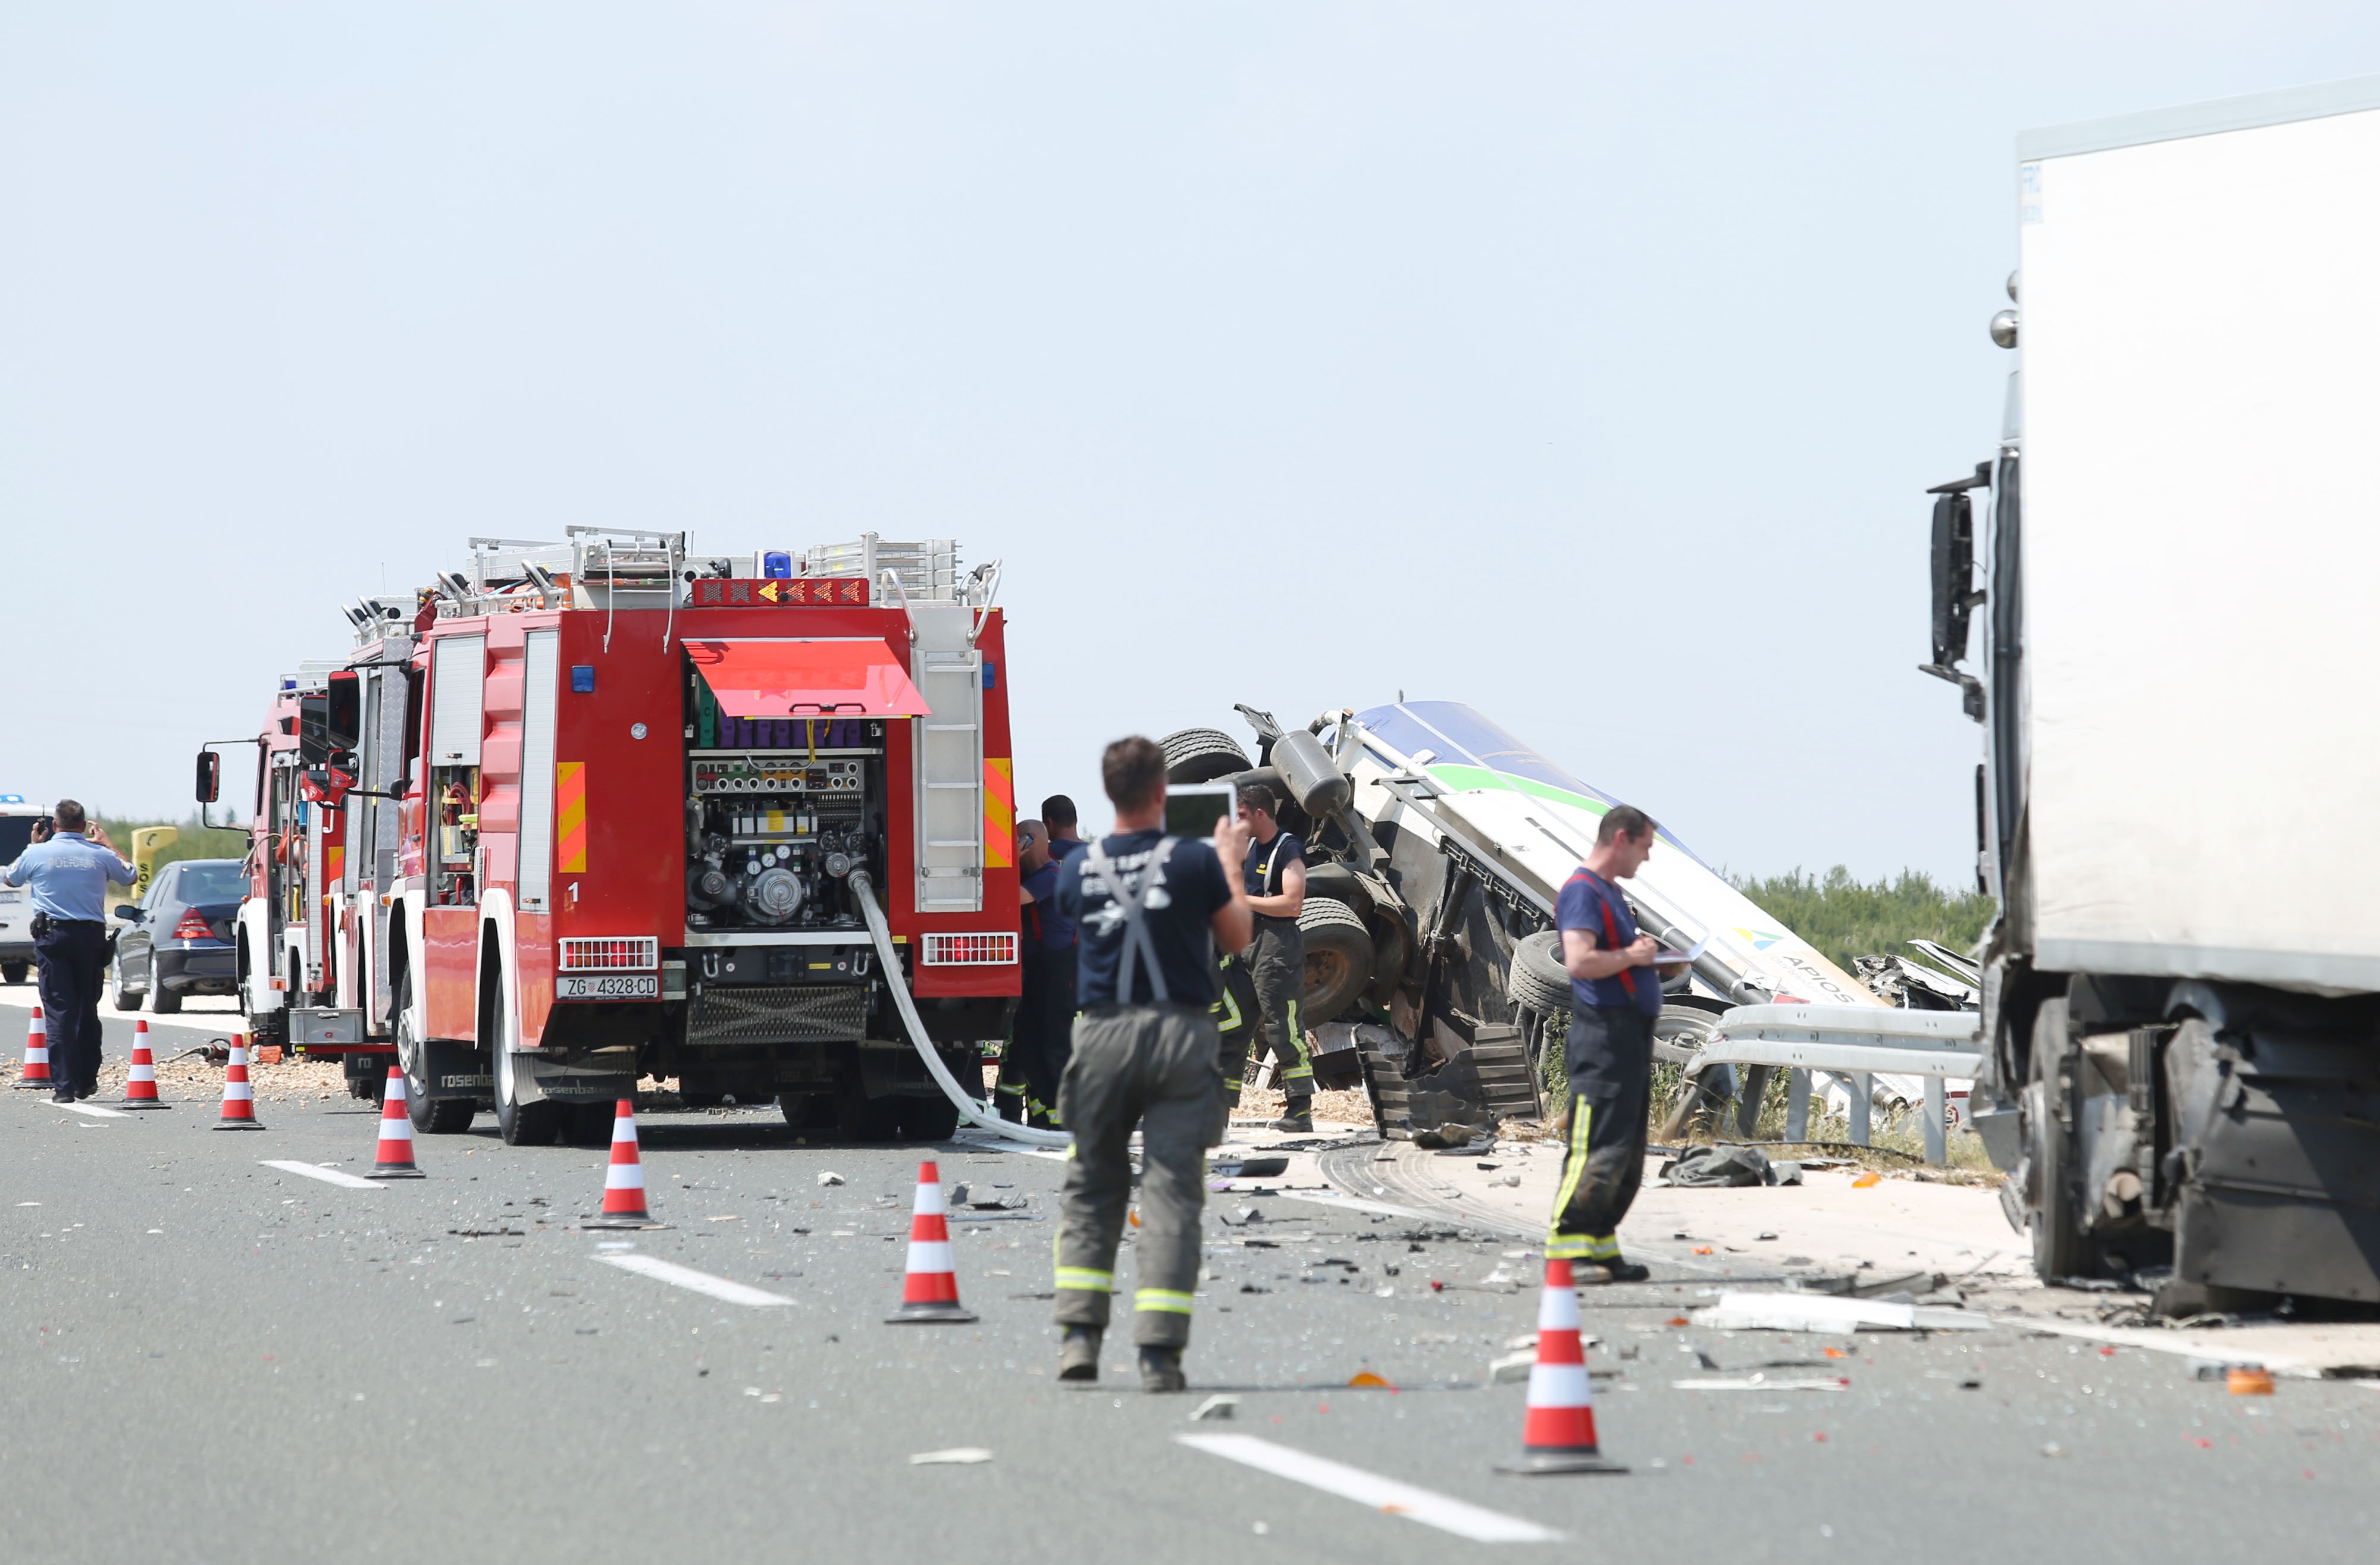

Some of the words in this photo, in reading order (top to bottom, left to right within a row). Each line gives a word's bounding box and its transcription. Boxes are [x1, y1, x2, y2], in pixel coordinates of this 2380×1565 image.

[48, 857, 96, 869] POLICIJA
[139, 863, 149, 893] SOS
[568, 882, 578, 902] 1
[568, 979, 586, 995] ZG
[1783, 956, 1855, 1003] APIOS
[441, 1064, 493, 1087] rosenba
[544, 1079, 616, 1094] osenbauer
